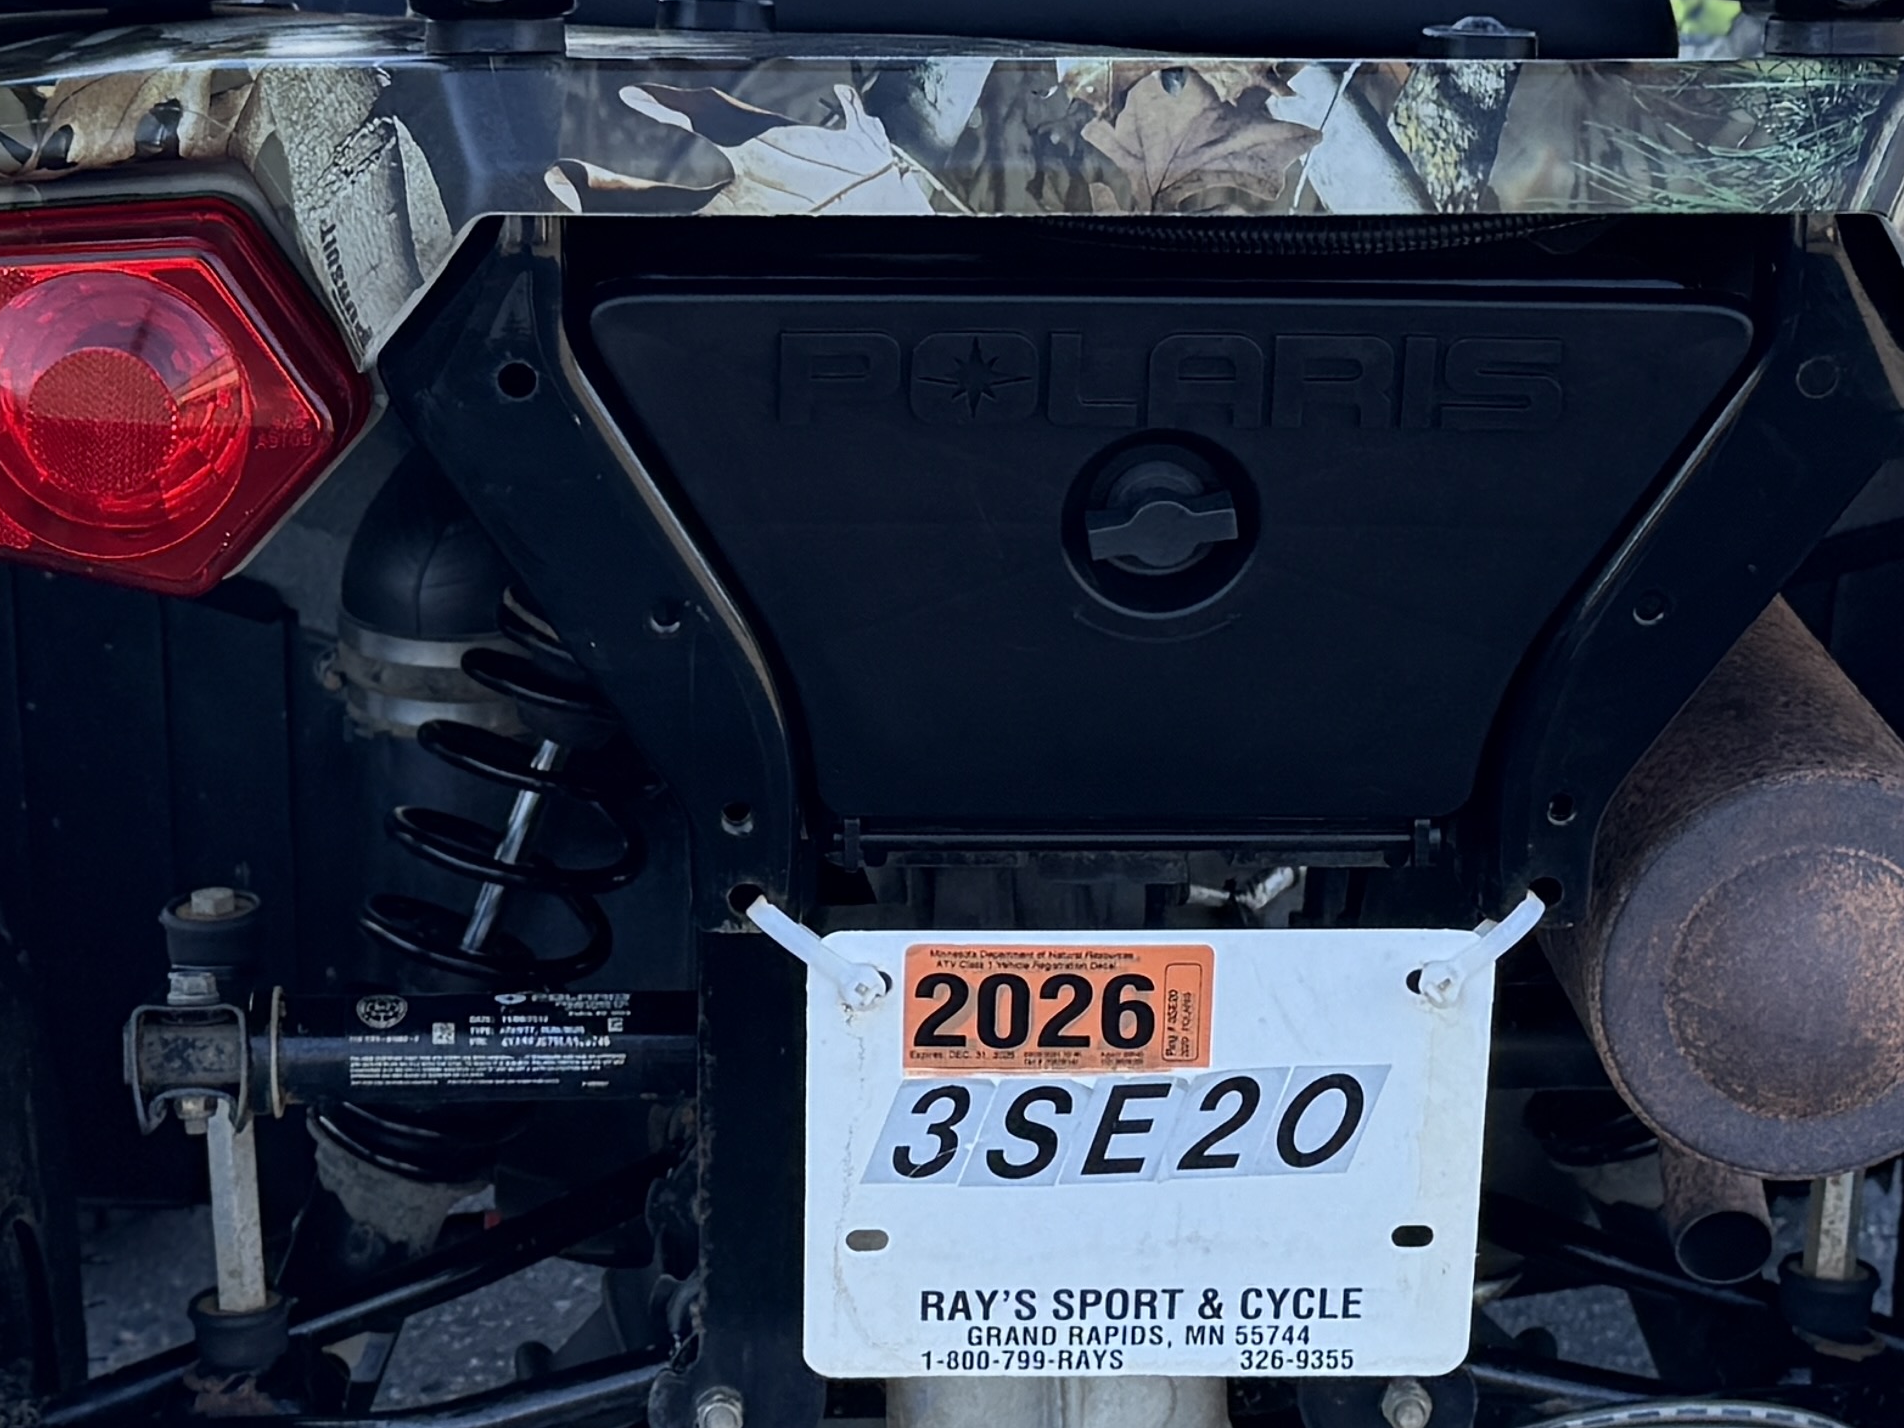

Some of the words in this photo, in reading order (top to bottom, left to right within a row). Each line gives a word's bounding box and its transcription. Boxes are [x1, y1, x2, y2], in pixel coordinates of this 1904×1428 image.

[778, 328, 1566, 430] POLARIS
[914, 972, 1155, 1049] 2026
[892, 1073, 1364, 1180] 3SE20
[920, 1289, 1036, 1322] RAY'S
[1052, 1288, 1185, 1321] SPORT
[1197, 1287, 1223, 1320] &
[1240, 1287, 1363, 1320] CYCLE
[921, 1349, 1124, 1371] 1-800-799-RAYS
[1240, 1349, 1354, 1370] 326-9355
[967, 1325, 1057, 1346] GRAND
[1068, 1325, 1173, 1350] RAPIDS,
[1185, 1325, 1224, 1346] MN
[1235, 1325, 1310, 1346] 55744
